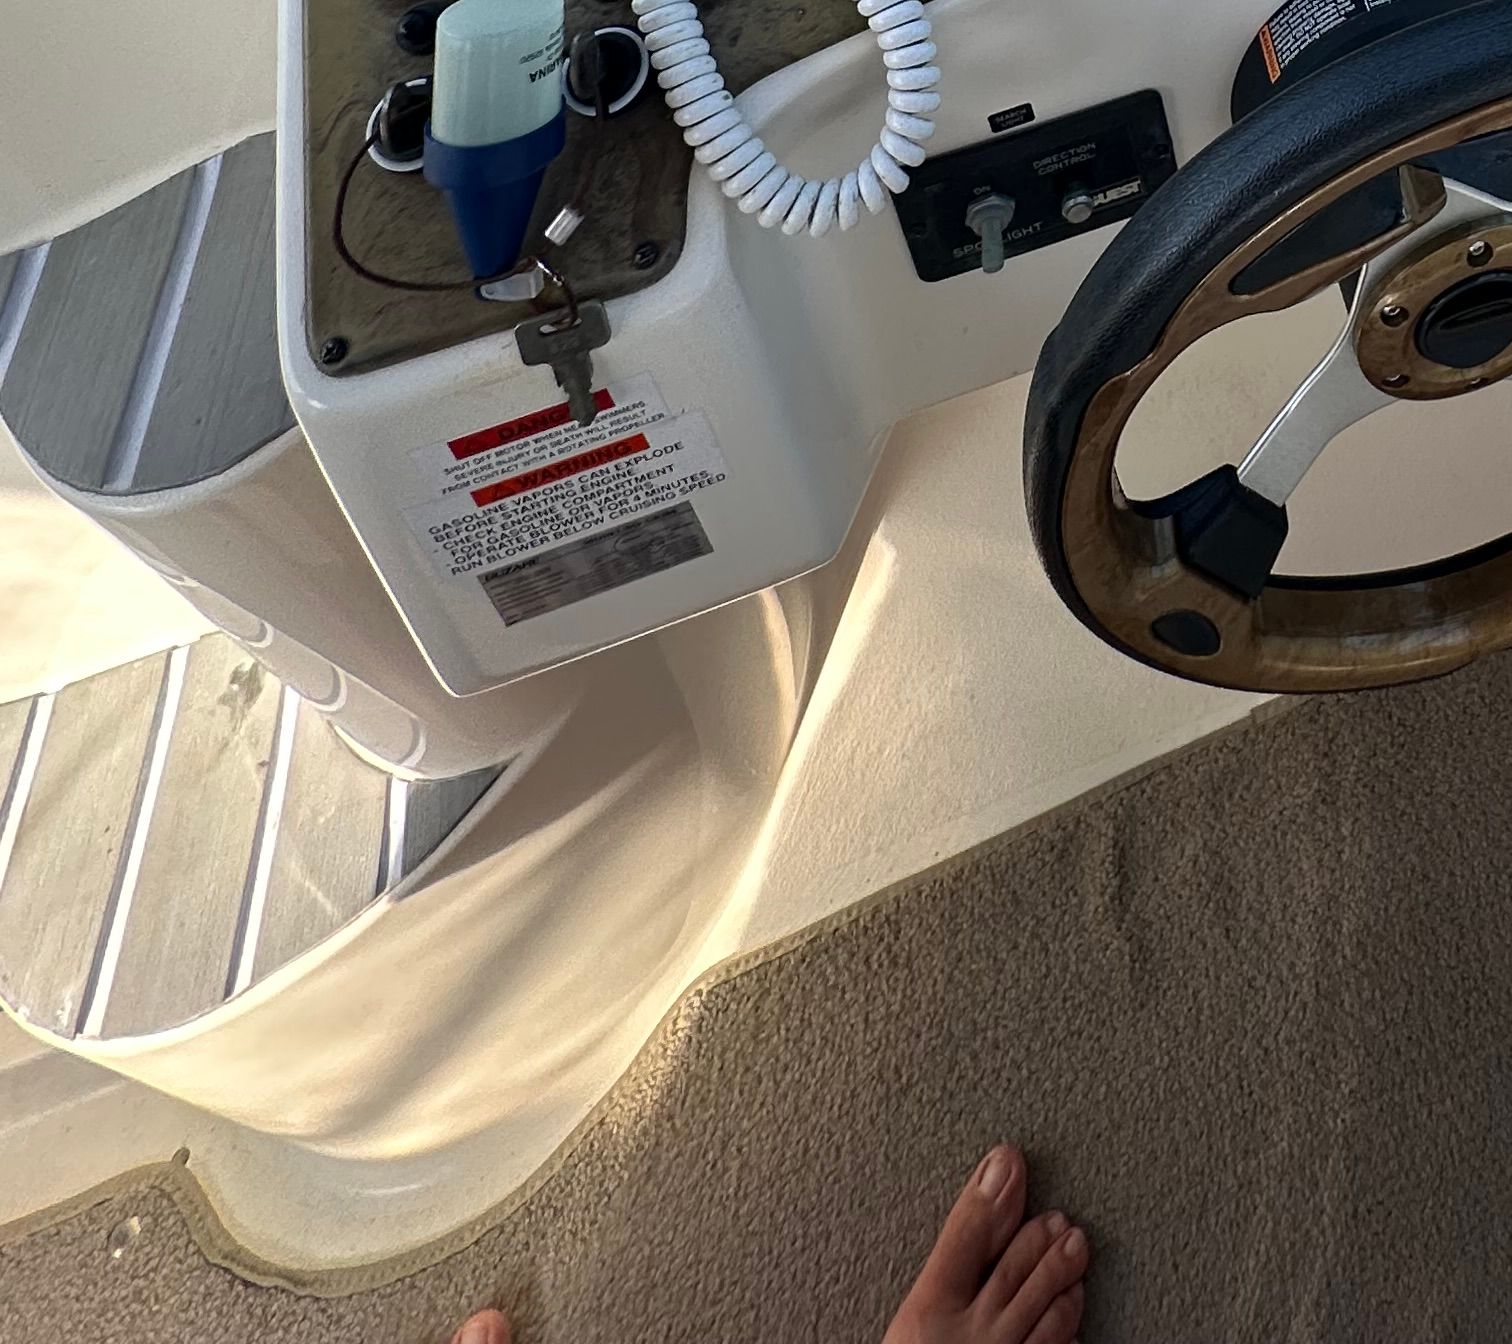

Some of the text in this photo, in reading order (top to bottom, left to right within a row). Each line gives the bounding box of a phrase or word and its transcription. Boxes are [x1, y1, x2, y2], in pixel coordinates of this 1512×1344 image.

[1033, 142, 1097, 169] DIRECTION
[1038, 152, 1097, 175] CONTROL
[953, 221, 1043, 258] SPOIGHT
[428, 440, 685, 535] GASOLINE VAPORS CAN EXPLODE
[518, 442, 634, 488] WARNING
[433, 516, 498, 543] BEFORE
[501, 489, 577, 520] STARTING
[443, 527, 496, 550] CHECK
[501, 505, 560, 531] ENGINE
[562, 463, 675, 509] COMPARTMENT
[451, 559, 483, 575] RUN
[486, 535, 551, 564] BLOWER
[552, 516, 605, 540] BELOW
[609, 491, 677, 520] CRUISING
[678, 473, 727, 496] SPEED
[451, 541, 483, 557] FOR
[486, 513, 565, 544] GASOLINE
[568, 503, 591, 516] OR
[454, 535, 527, 565] OPERATE
[529, 511, 595, 539] BLOWER
[598, 499, 630, 515] FOR
[633, 494, 642, 502] 4
